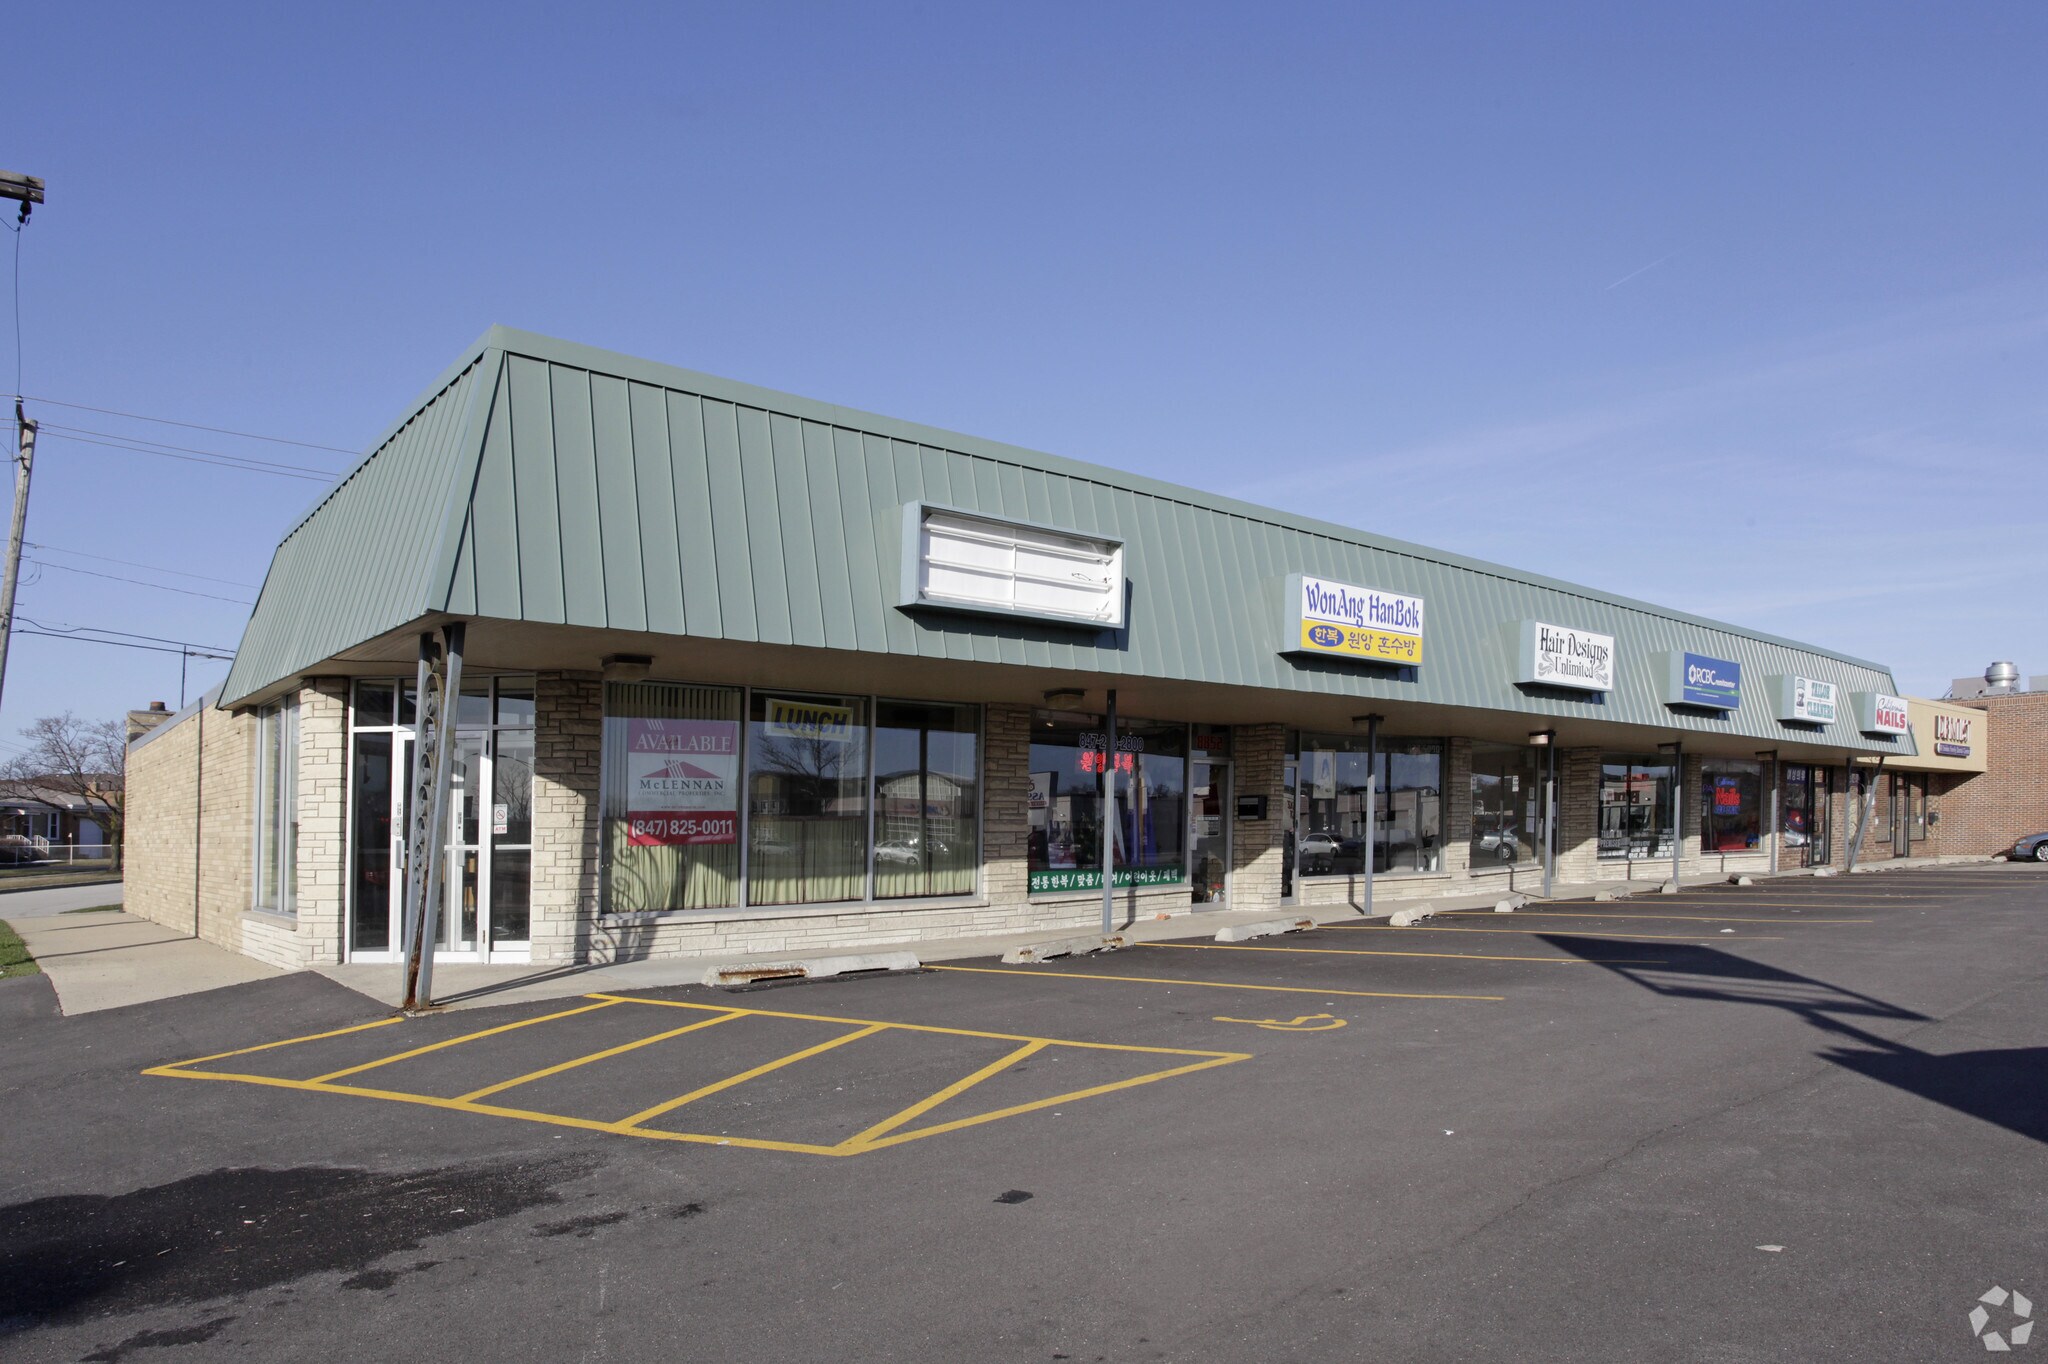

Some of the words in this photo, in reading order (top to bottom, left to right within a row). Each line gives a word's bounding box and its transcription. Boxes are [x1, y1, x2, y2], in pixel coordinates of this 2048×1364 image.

[1306, 582, 1365, 628] WonAng
[1369, 594, 1419, 629] HanBok
[1315, 627, 1339, 645] 한복
[1348, 631, 1374, 651] 원앙
[1378, 636, 1416, 657] 혼수방
[1540, 627, 1565, 655] Hair
[1568, 632, 1609, 666] Designs
[1554, 656, 1594, 679] Unlimited
[1696, 667, 1716, 686] RCBC
[774, 706, 848, 735] LUNCH
[1876, 708, 1906, 729] NAILS
[635, 733, 732, 752] AVAILABLE
[1715, 787, 1741, 805] Nails
[632, 820, 667, 838] (847)
[670, 820, 733, 836] 825-0011
